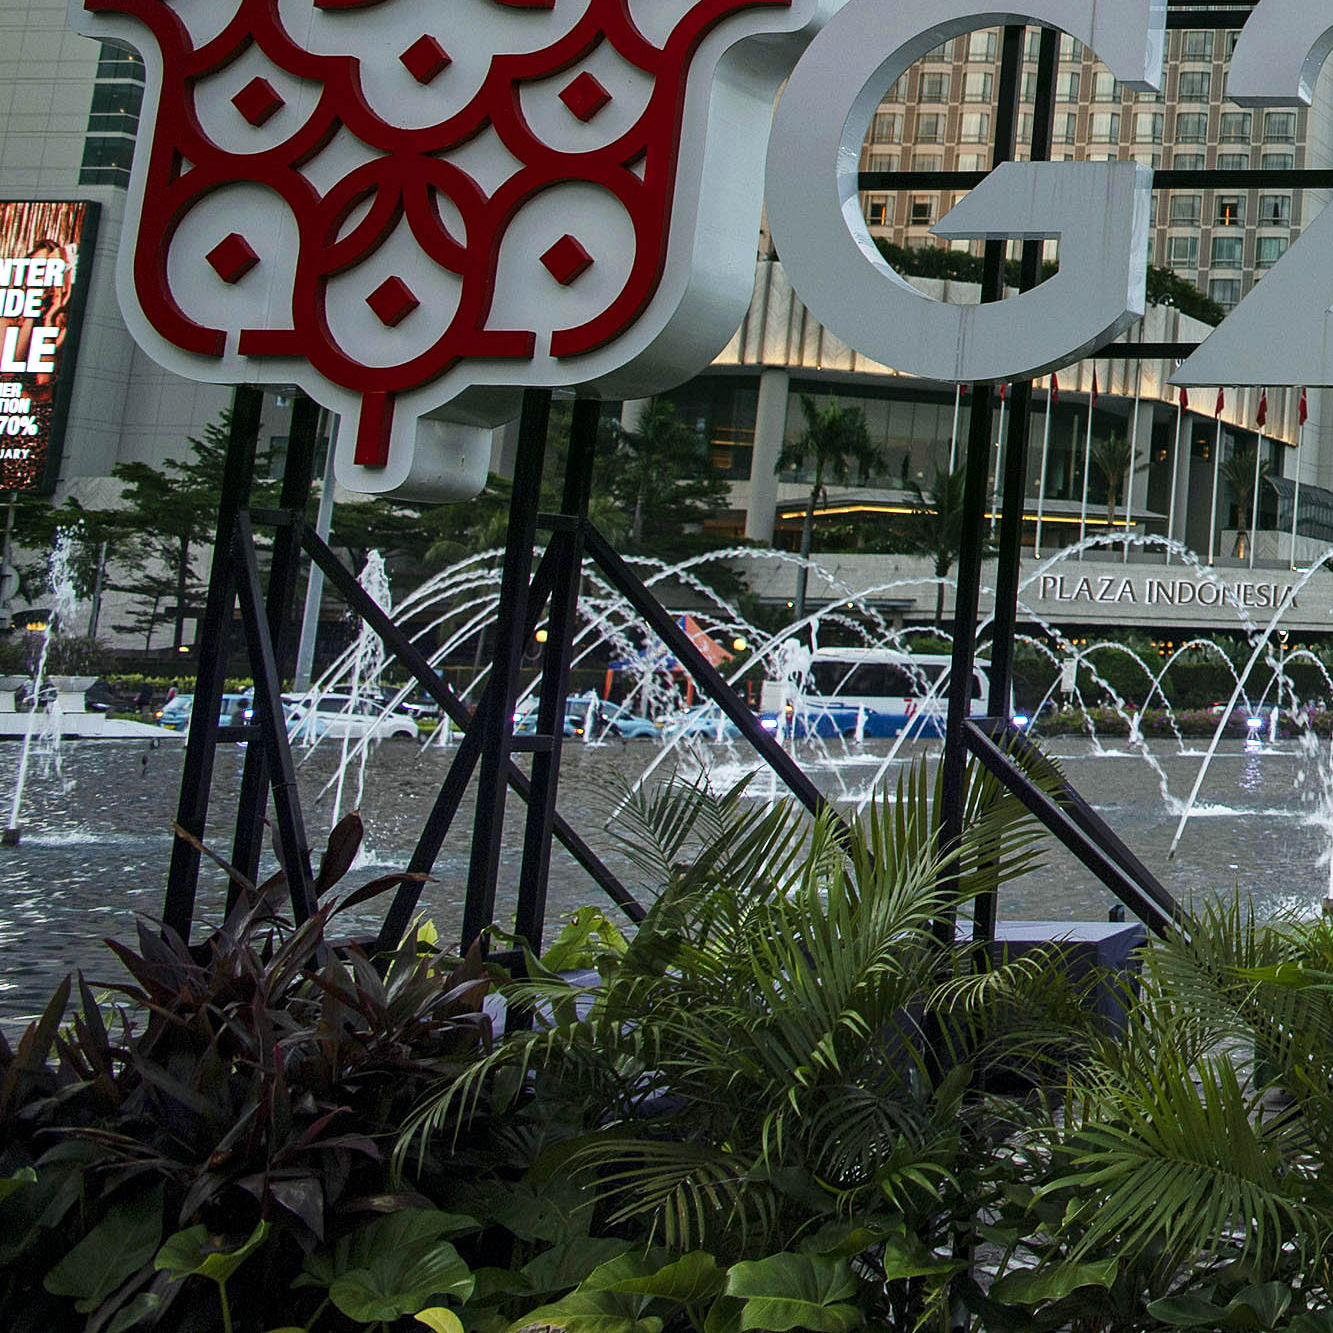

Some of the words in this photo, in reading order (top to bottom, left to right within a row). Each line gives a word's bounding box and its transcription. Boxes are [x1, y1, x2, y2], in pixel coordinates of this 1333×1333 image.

[0, 326, 59, 373] LE
[1039, 574, 1137, 603] PLAZA
[1144, 577, 1299, 608] INDONESIA
